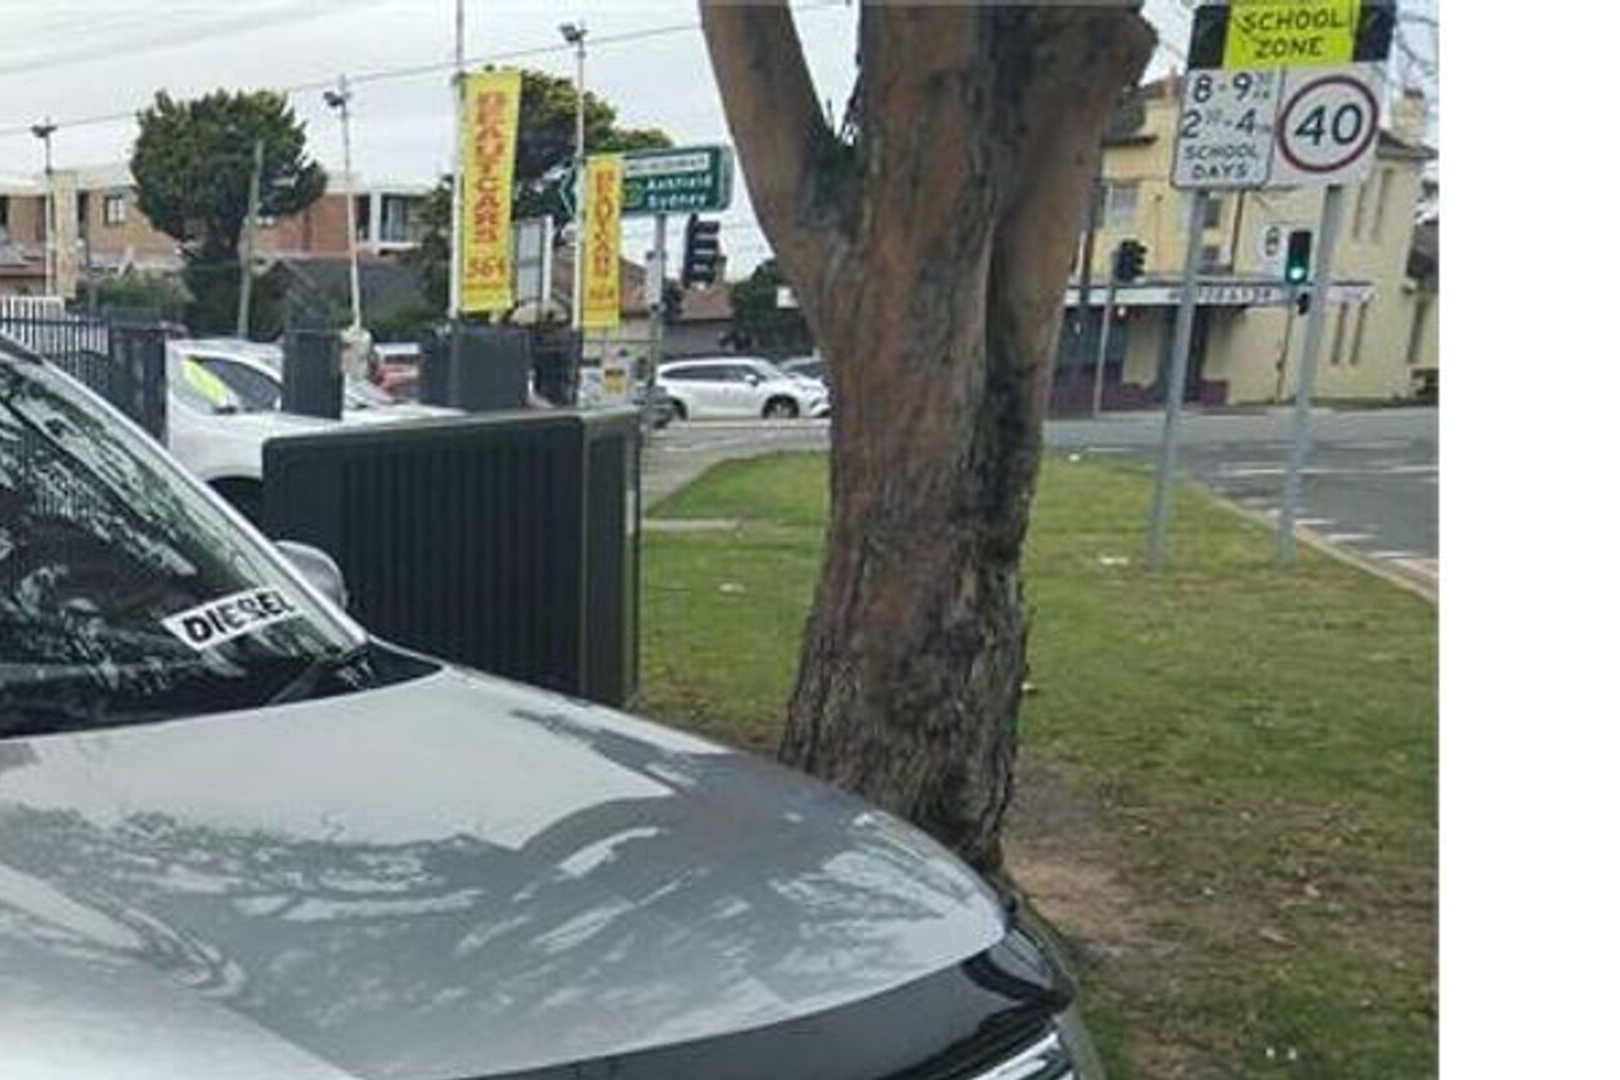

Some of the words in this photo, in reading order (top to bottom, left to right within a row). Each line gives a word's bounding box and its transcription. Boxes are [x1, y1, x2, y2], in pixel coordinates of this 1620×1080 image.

[1240, 9, 1345, 33] SCHOOL
[1255, 37, 1323, 58] ZONE
[1295, 103, 1363, 146] 40
[1183, 142, 1257, 160] SCHOOL
[1191, 162, 1248, 180] DAYS
[182, 591, 294, 642] DIESEL
